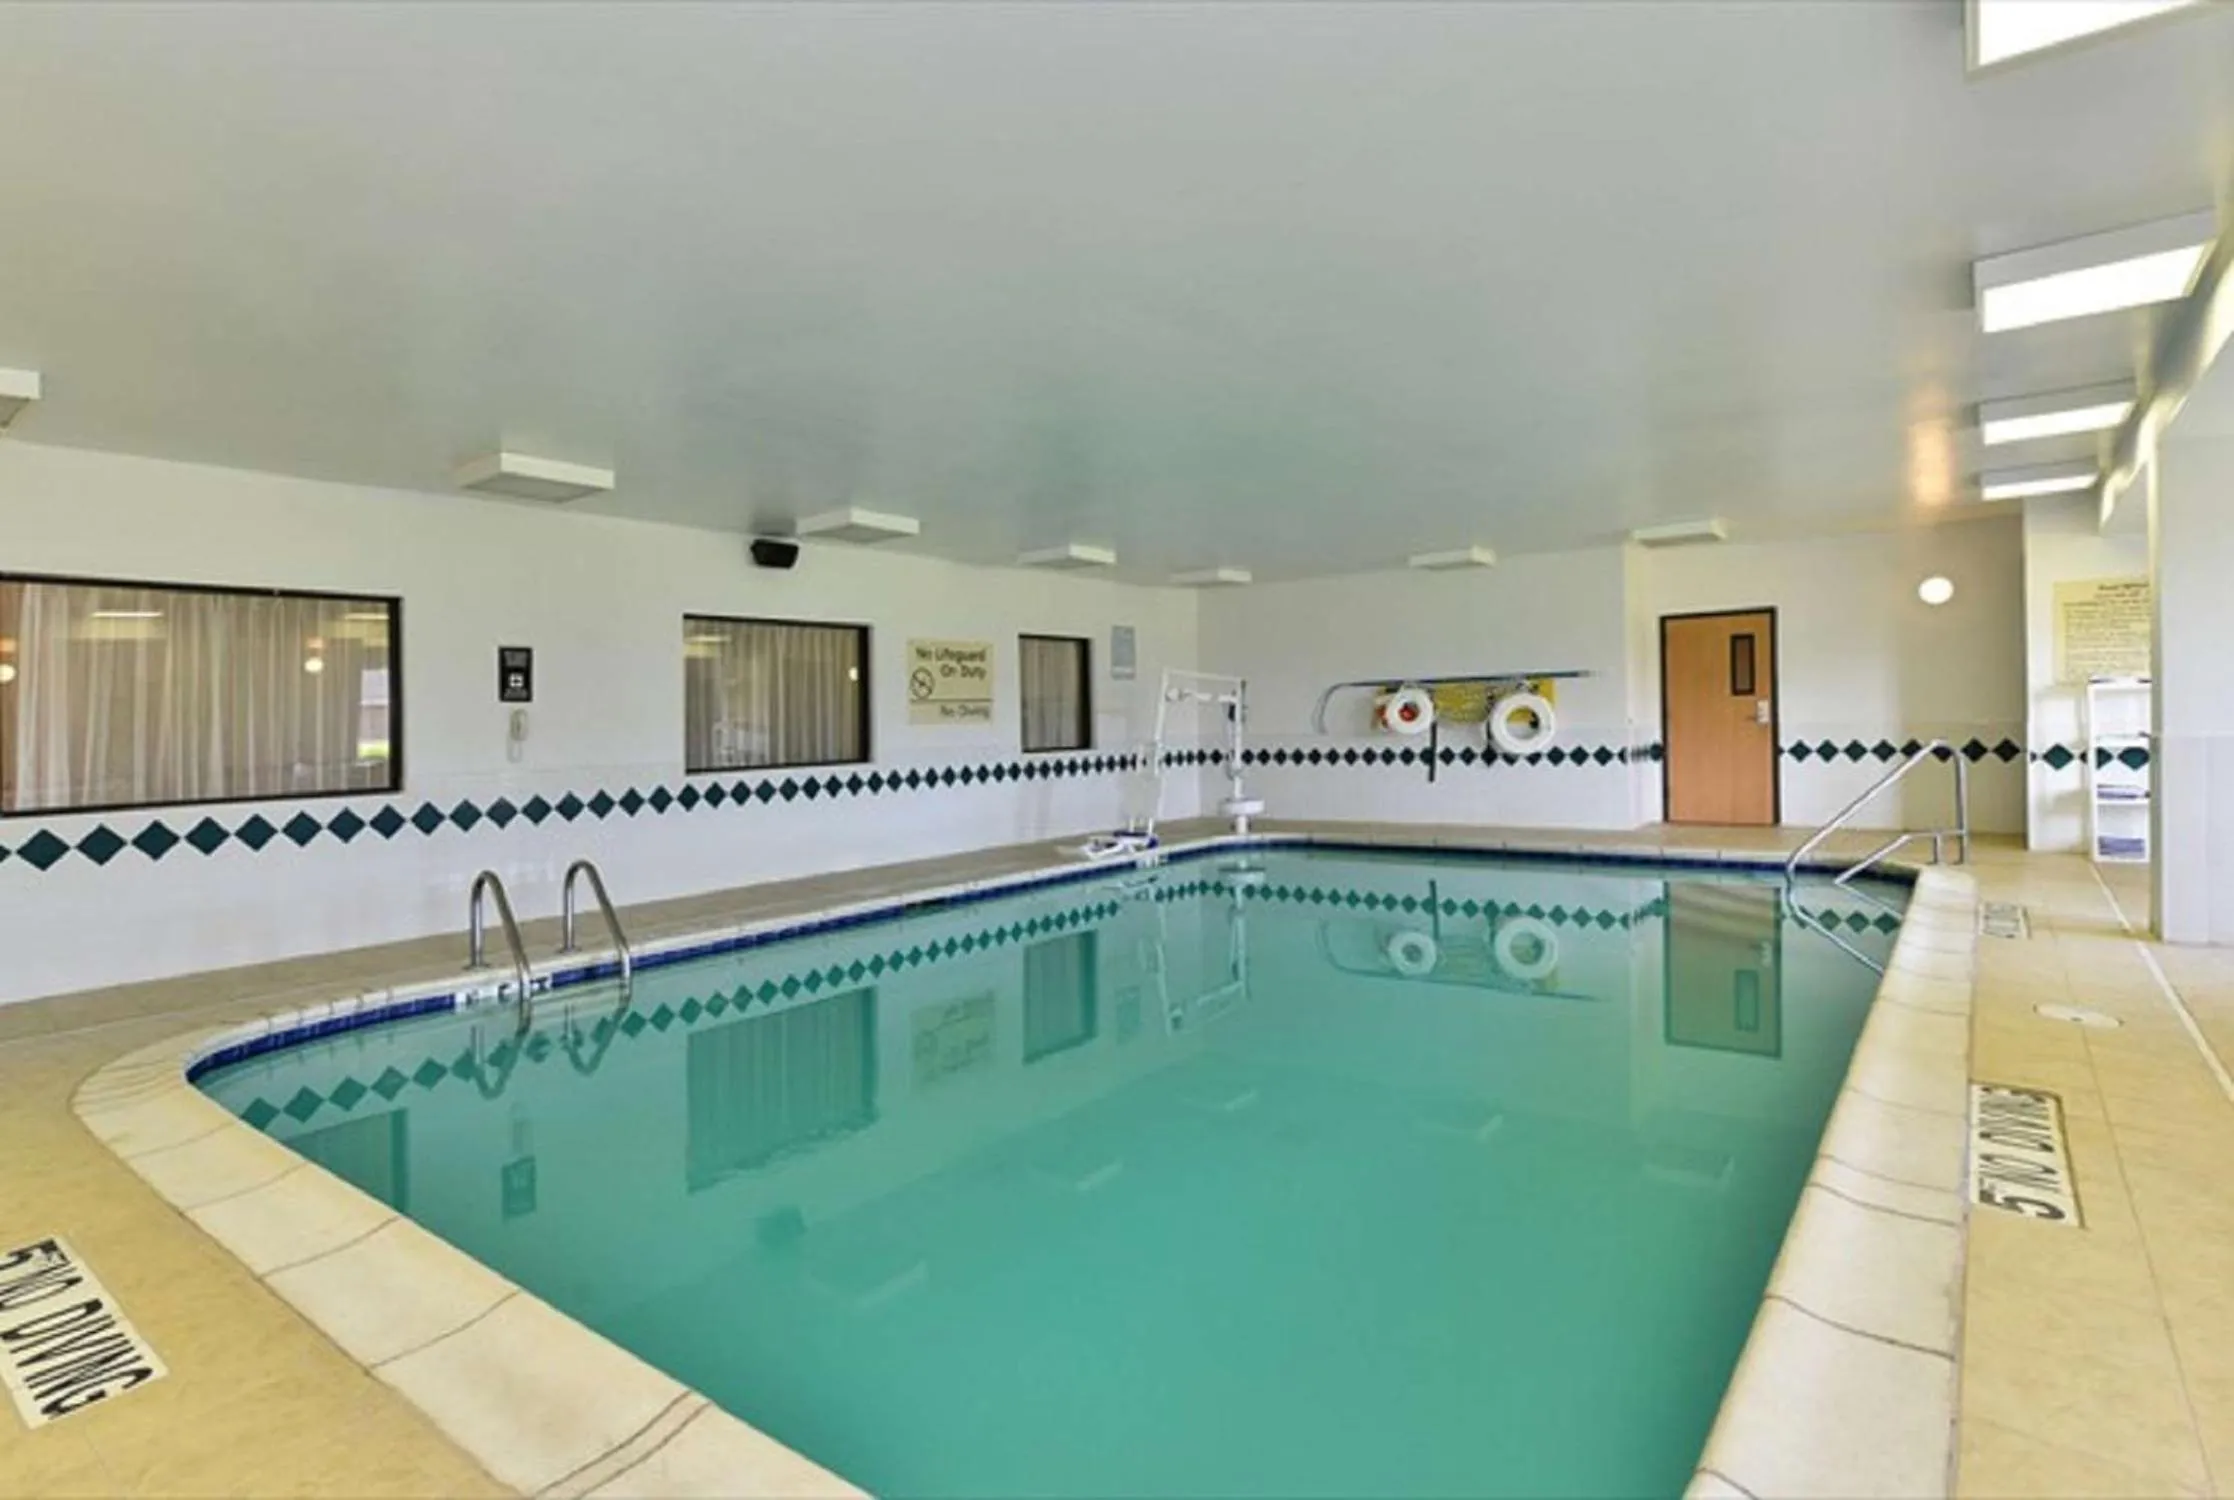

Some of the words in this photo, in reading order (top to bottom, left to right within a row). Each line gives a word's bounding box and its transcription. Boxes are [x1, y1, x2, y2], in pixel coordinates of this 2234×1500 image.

[915, 647, 932, 660] No
[934, 646, 986, 665] Lifeguard
[940, 663, 957, 678] On
[960, 664, 986, 680] Duty
[0, 1298, 153, 1420] DIVING
